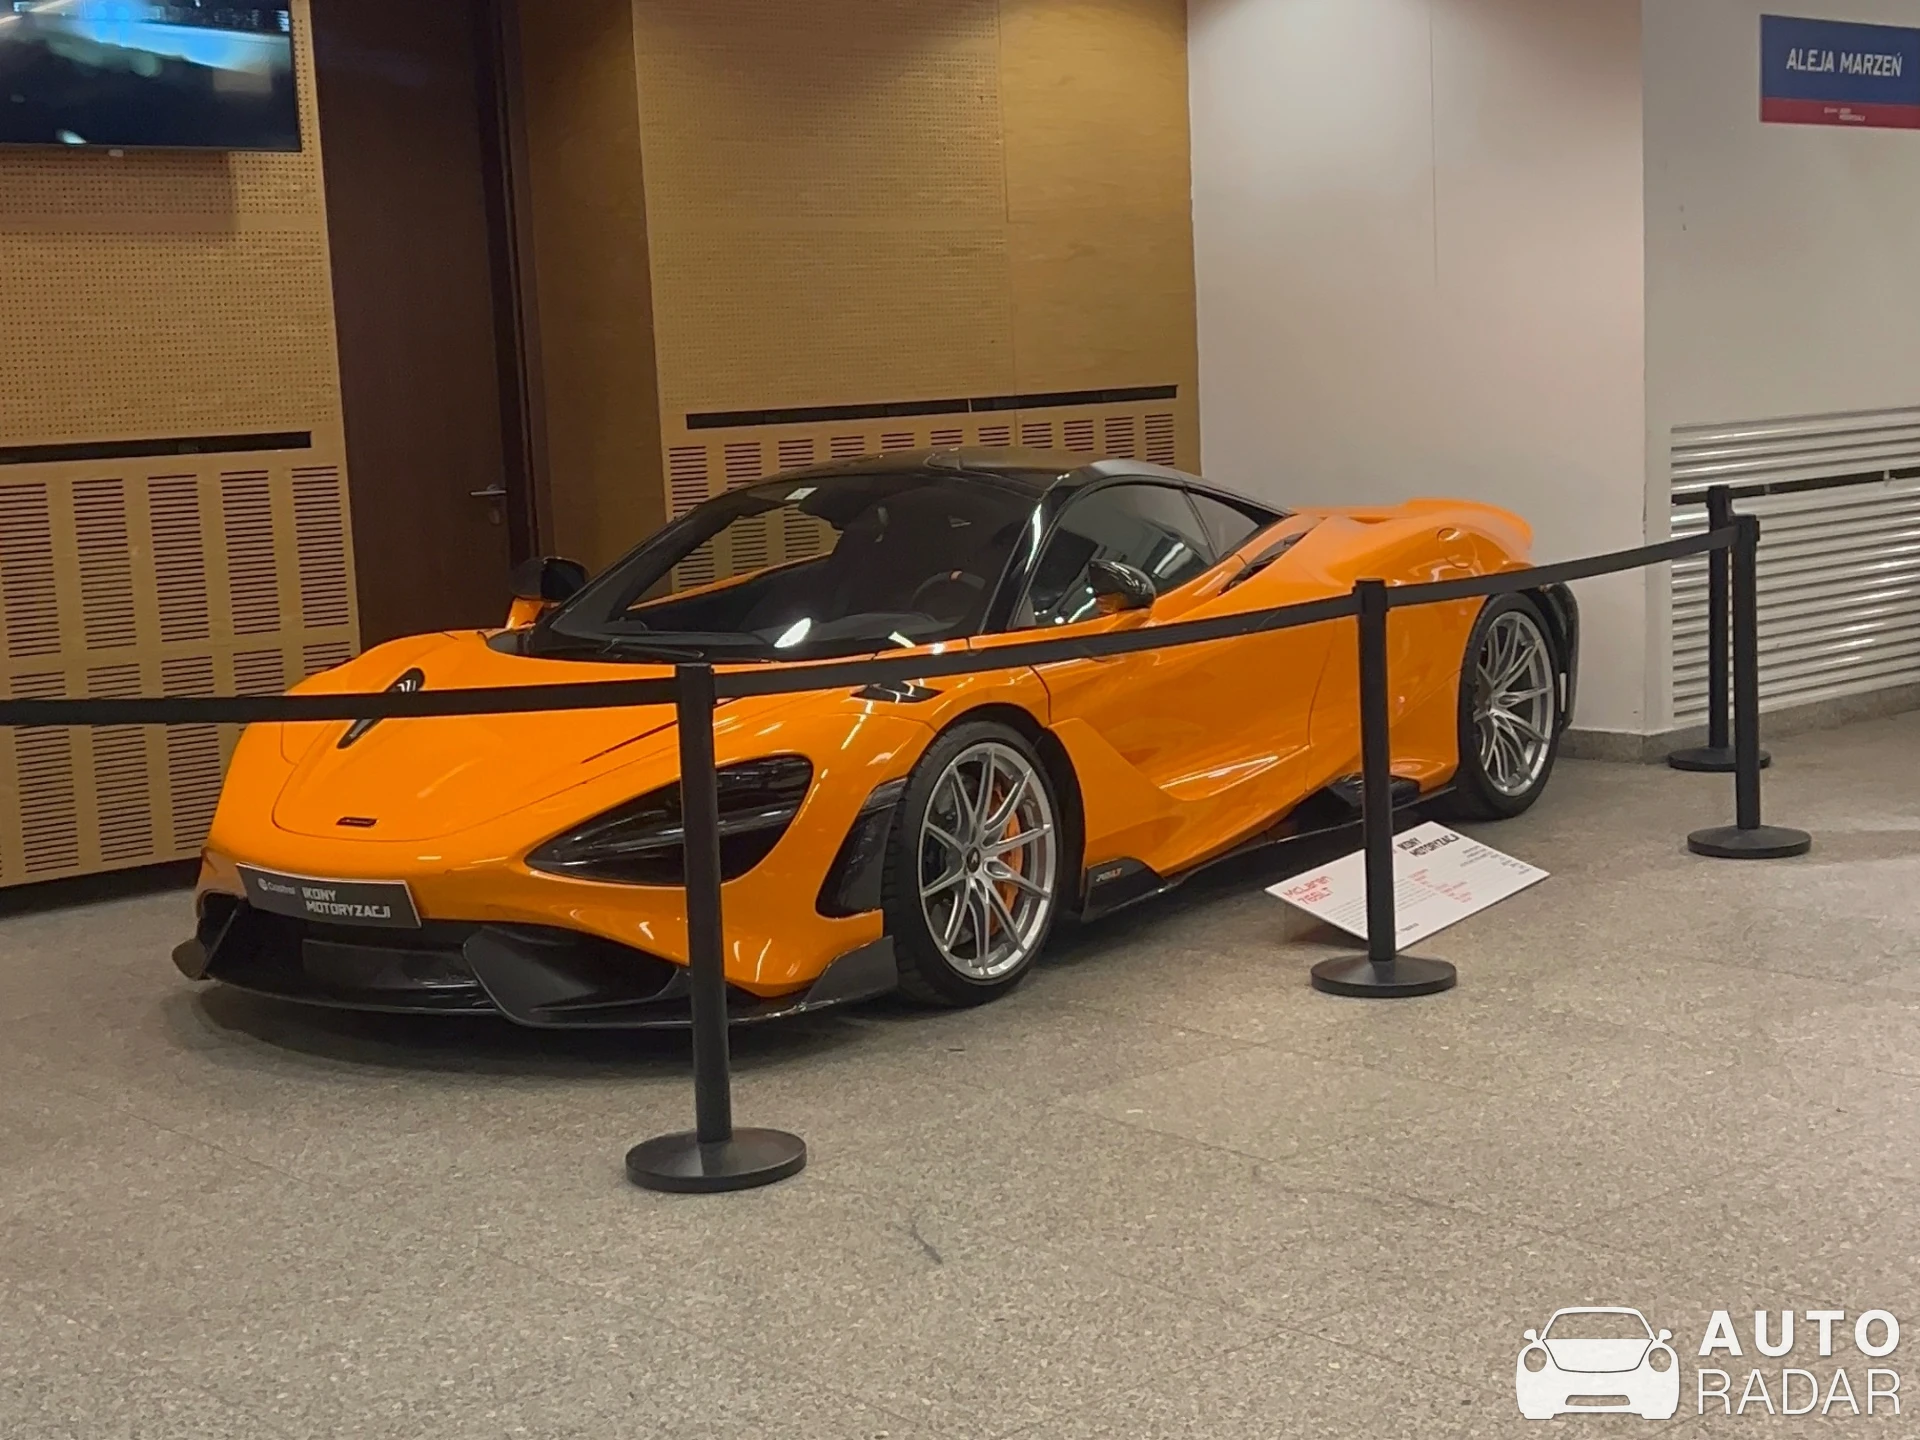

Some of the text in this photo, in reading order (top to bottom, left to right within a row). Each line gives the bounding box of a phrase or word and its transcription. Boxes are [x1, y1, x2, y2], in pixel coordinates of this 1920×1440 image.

[1786, 48, 1902, 77] ALEJA MARZEŃ
[302, 887, 336, 901] IKONY
[305, 901, 391, 918] MOTORYZACJI
